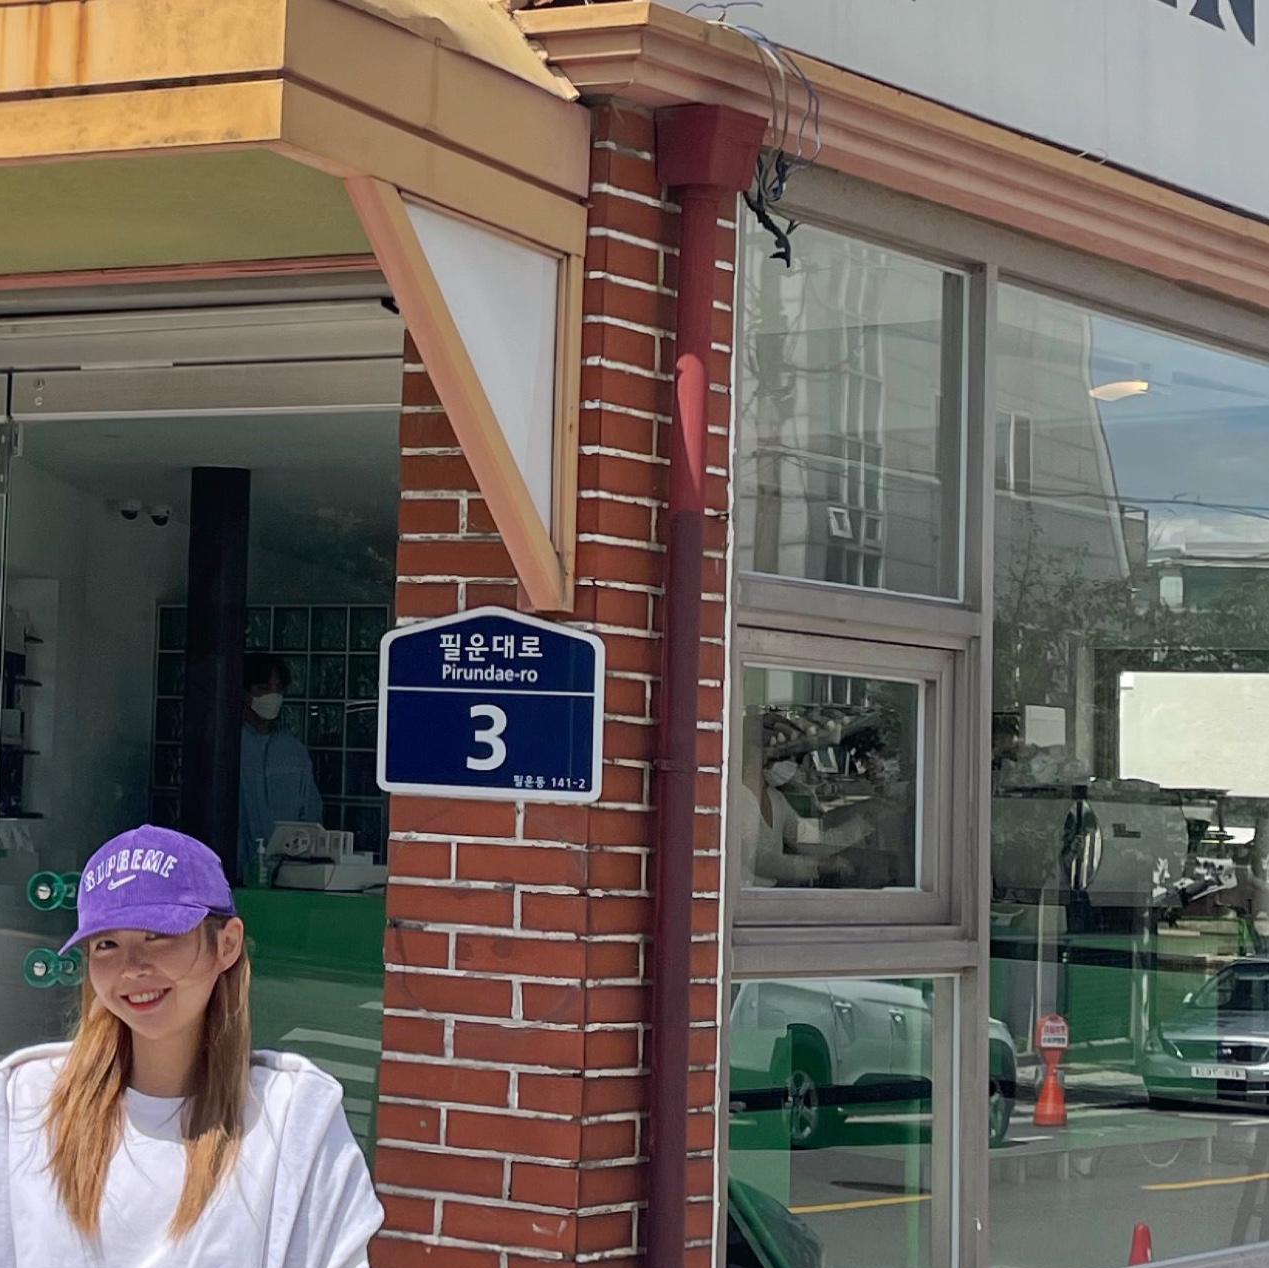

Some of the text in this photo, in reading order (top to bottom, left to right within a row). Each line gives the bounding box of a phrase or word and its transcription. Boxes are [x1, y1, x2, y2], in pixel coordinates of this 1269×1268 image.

[439, 633, 543, 662] 필운대로
[442, 664, 538, 683] Pirundae-ro
[466, 704, 508, 771] 3
[513, 774, 586, 789] 필운동 141-2
[83, 848, 178, 892] SUPREME
